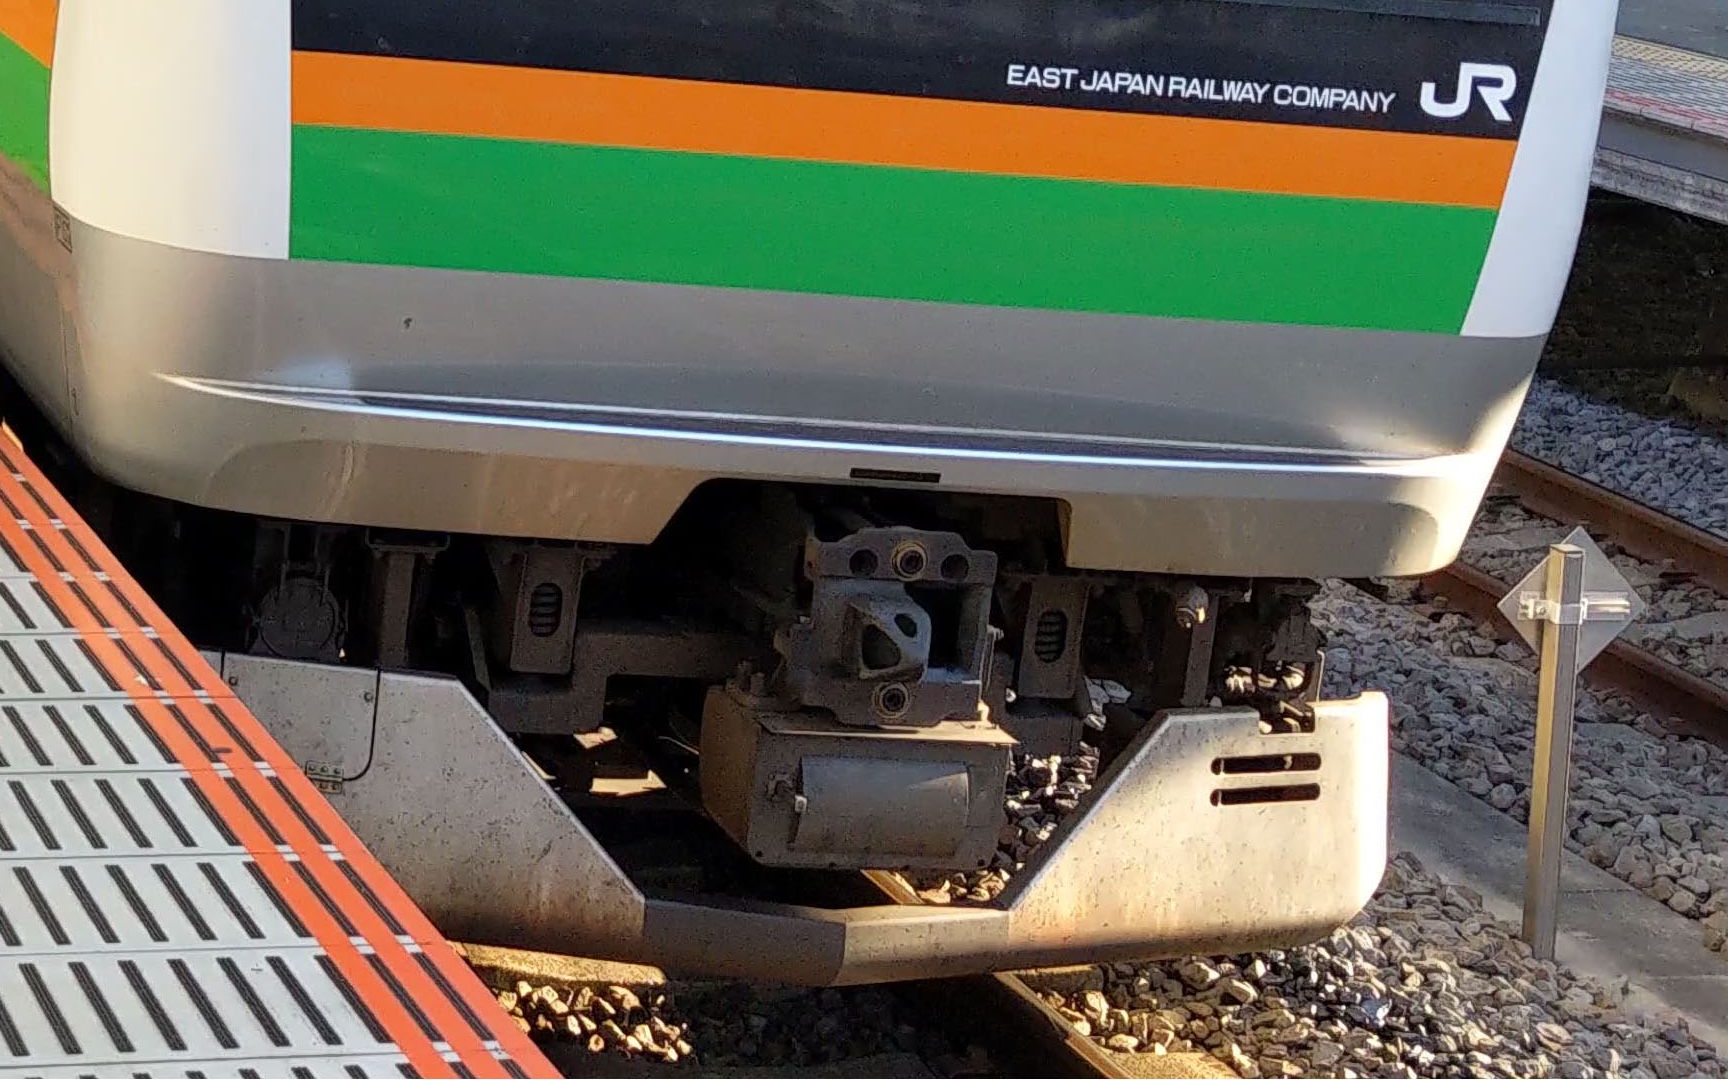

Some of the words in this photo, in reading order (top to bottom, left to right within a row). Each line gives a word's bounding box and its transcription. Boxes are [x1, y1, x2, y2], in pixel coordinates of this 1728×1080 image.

[1007, 64, 1079, 89] EAST
[1080, 69, 1164, 97] JAPAN
[1168, 76, 1271, 104] RAILWAY
[1273, 84, 1396, 113] COMPANY
[1419, 62, 1518, 122] JR
